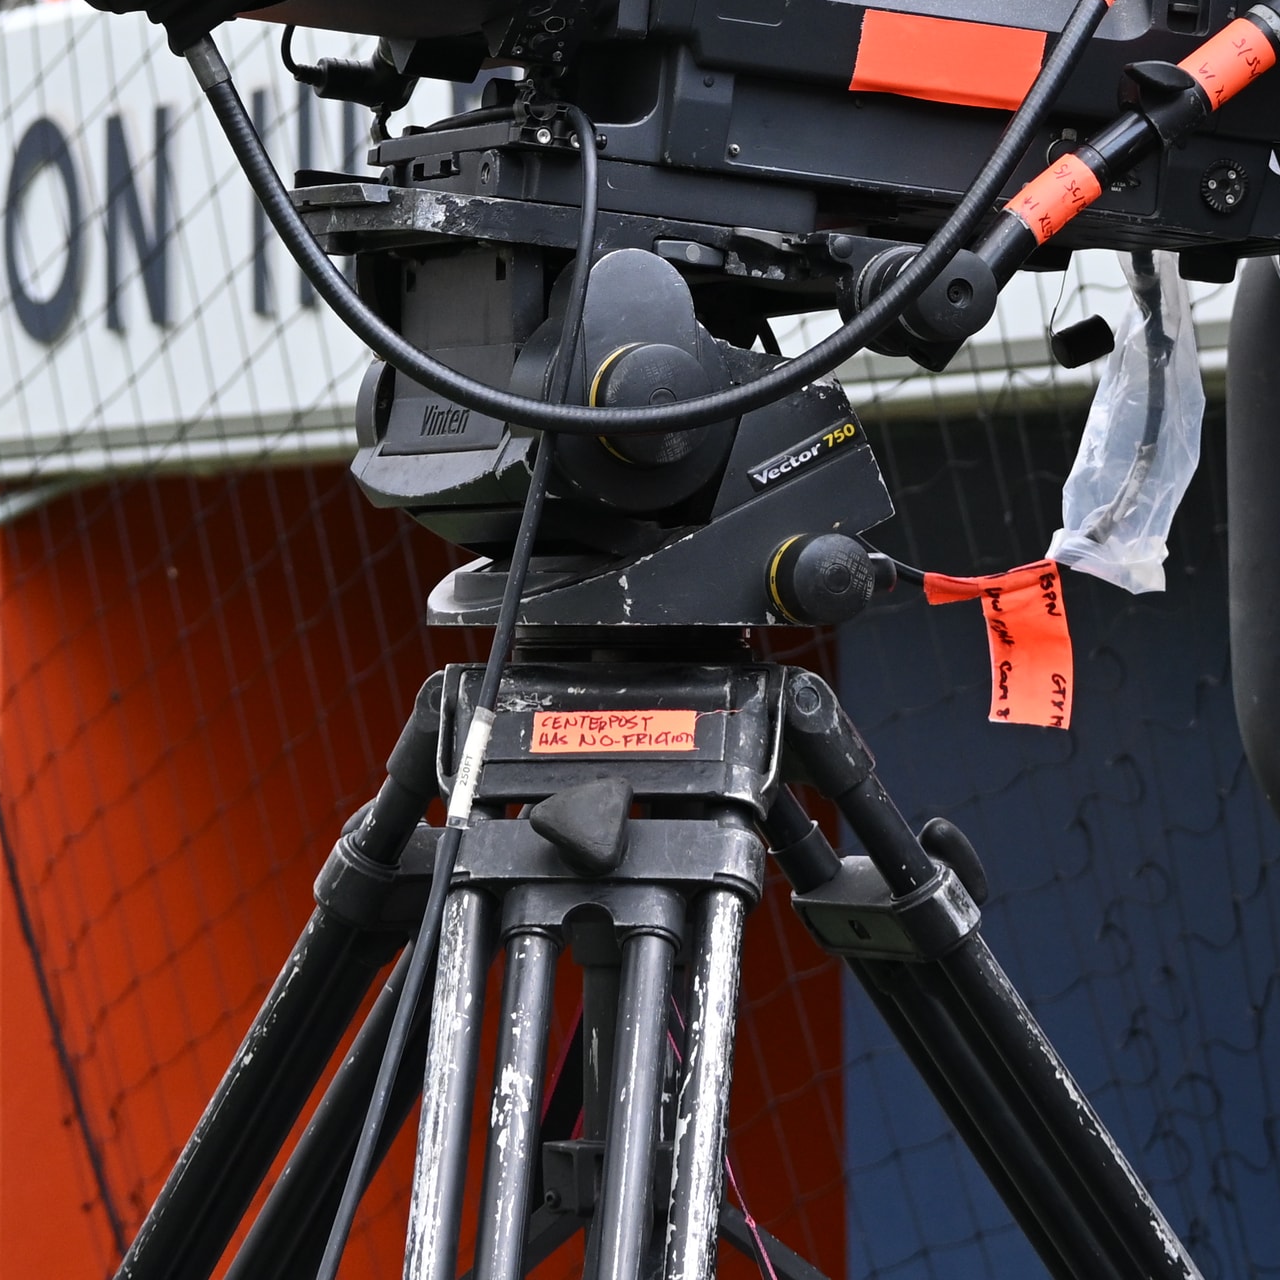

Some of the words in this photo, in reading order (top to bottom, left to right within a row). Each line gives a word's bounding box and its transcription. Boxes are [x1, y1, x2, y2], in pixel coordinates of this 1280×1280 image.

[420, 403, 471, 437] Vinten
[753, 443, 821, 484] Vector
[822, 423, 855, 448] 750
[1039, 572, 1062, 617] ESPN
[538, 732, 569, 746] HAS
[459, 755, 474, 787] 250FT
